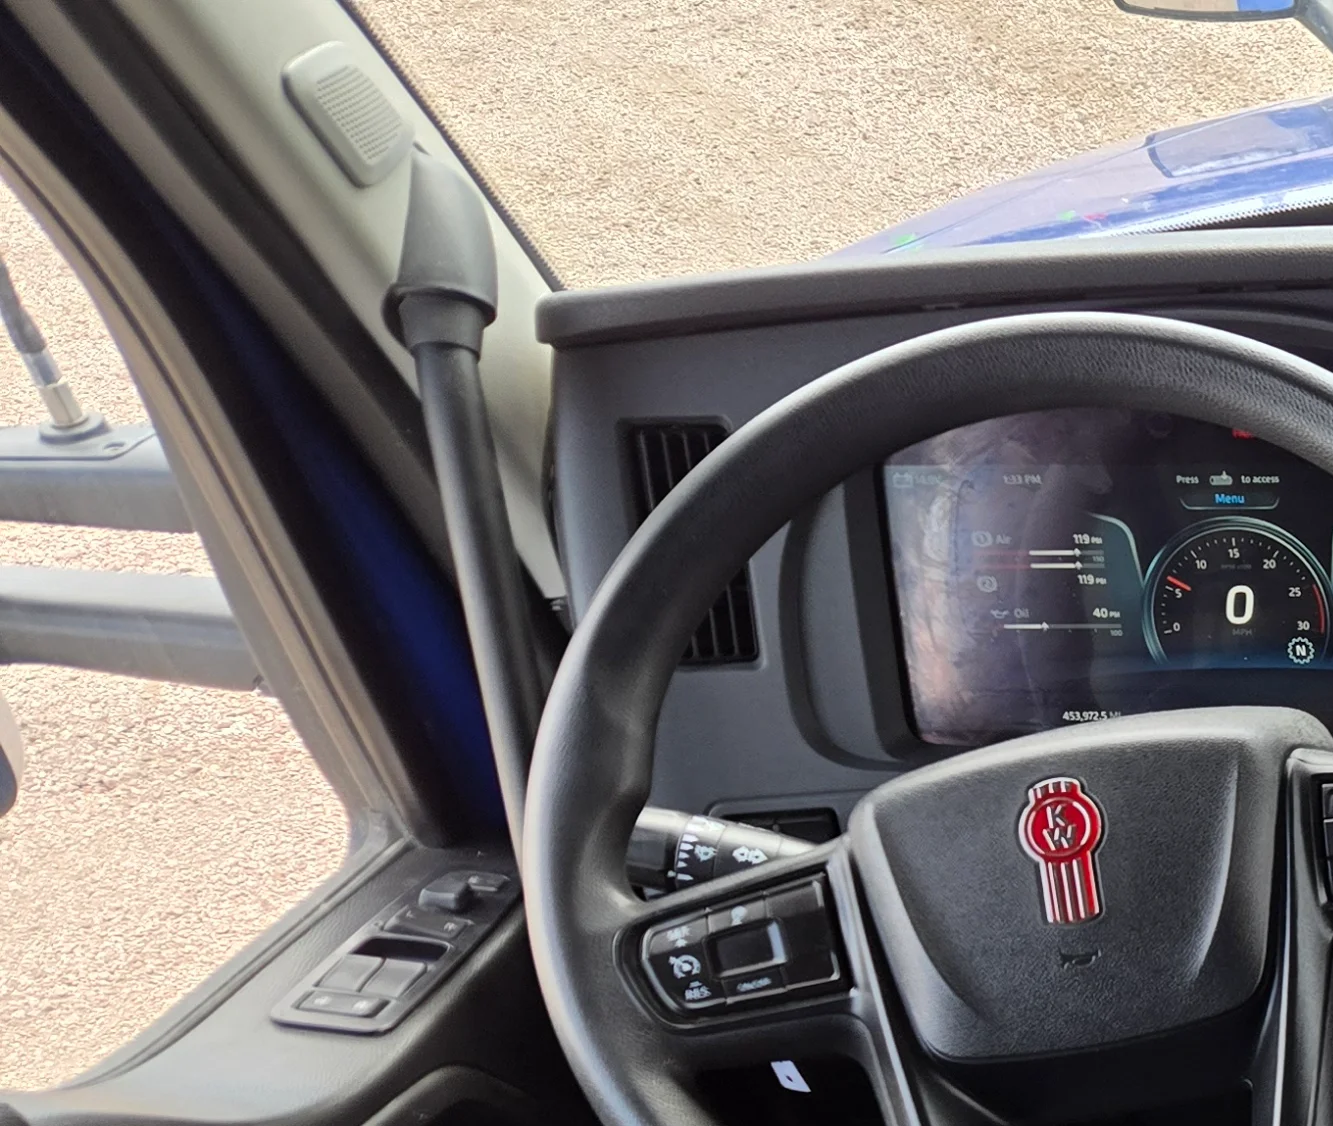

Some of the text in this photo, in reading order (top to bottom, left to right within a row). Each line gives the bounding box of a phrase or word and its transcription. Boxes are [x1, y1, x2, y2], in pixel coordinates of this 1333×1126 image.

[1024, 474, 1042, 485] PM
[1176, 475, 1280, 484] Press to access
[1215, 493, 1245, 504] Menu
[1073, 534, 1091, 545] 119
[1228, 548, 1240, 559] 15
[1195, 559, 1207, 570] 10
[1262, 559, 1277, 570] 20
[1078, 574, 1095, 585] 119
[1175, 588, 1183, 598] 5
[1288, 586, 1302, 597] 25
[1225, 584, 1255, 625] 0
[1014, 608, 1030, 619] Oil
[1093, 608, 1109, 618] 40
[1173, 623, 1181, 632] 0
[1297, 620, 1310, 631] 30
[1295, 644, 1307, 656] N
[1062, 711, 1108, 722] 453,972.5
[1046, 804, 1070, 829] K
[1042, 824, 1077, 850] W
